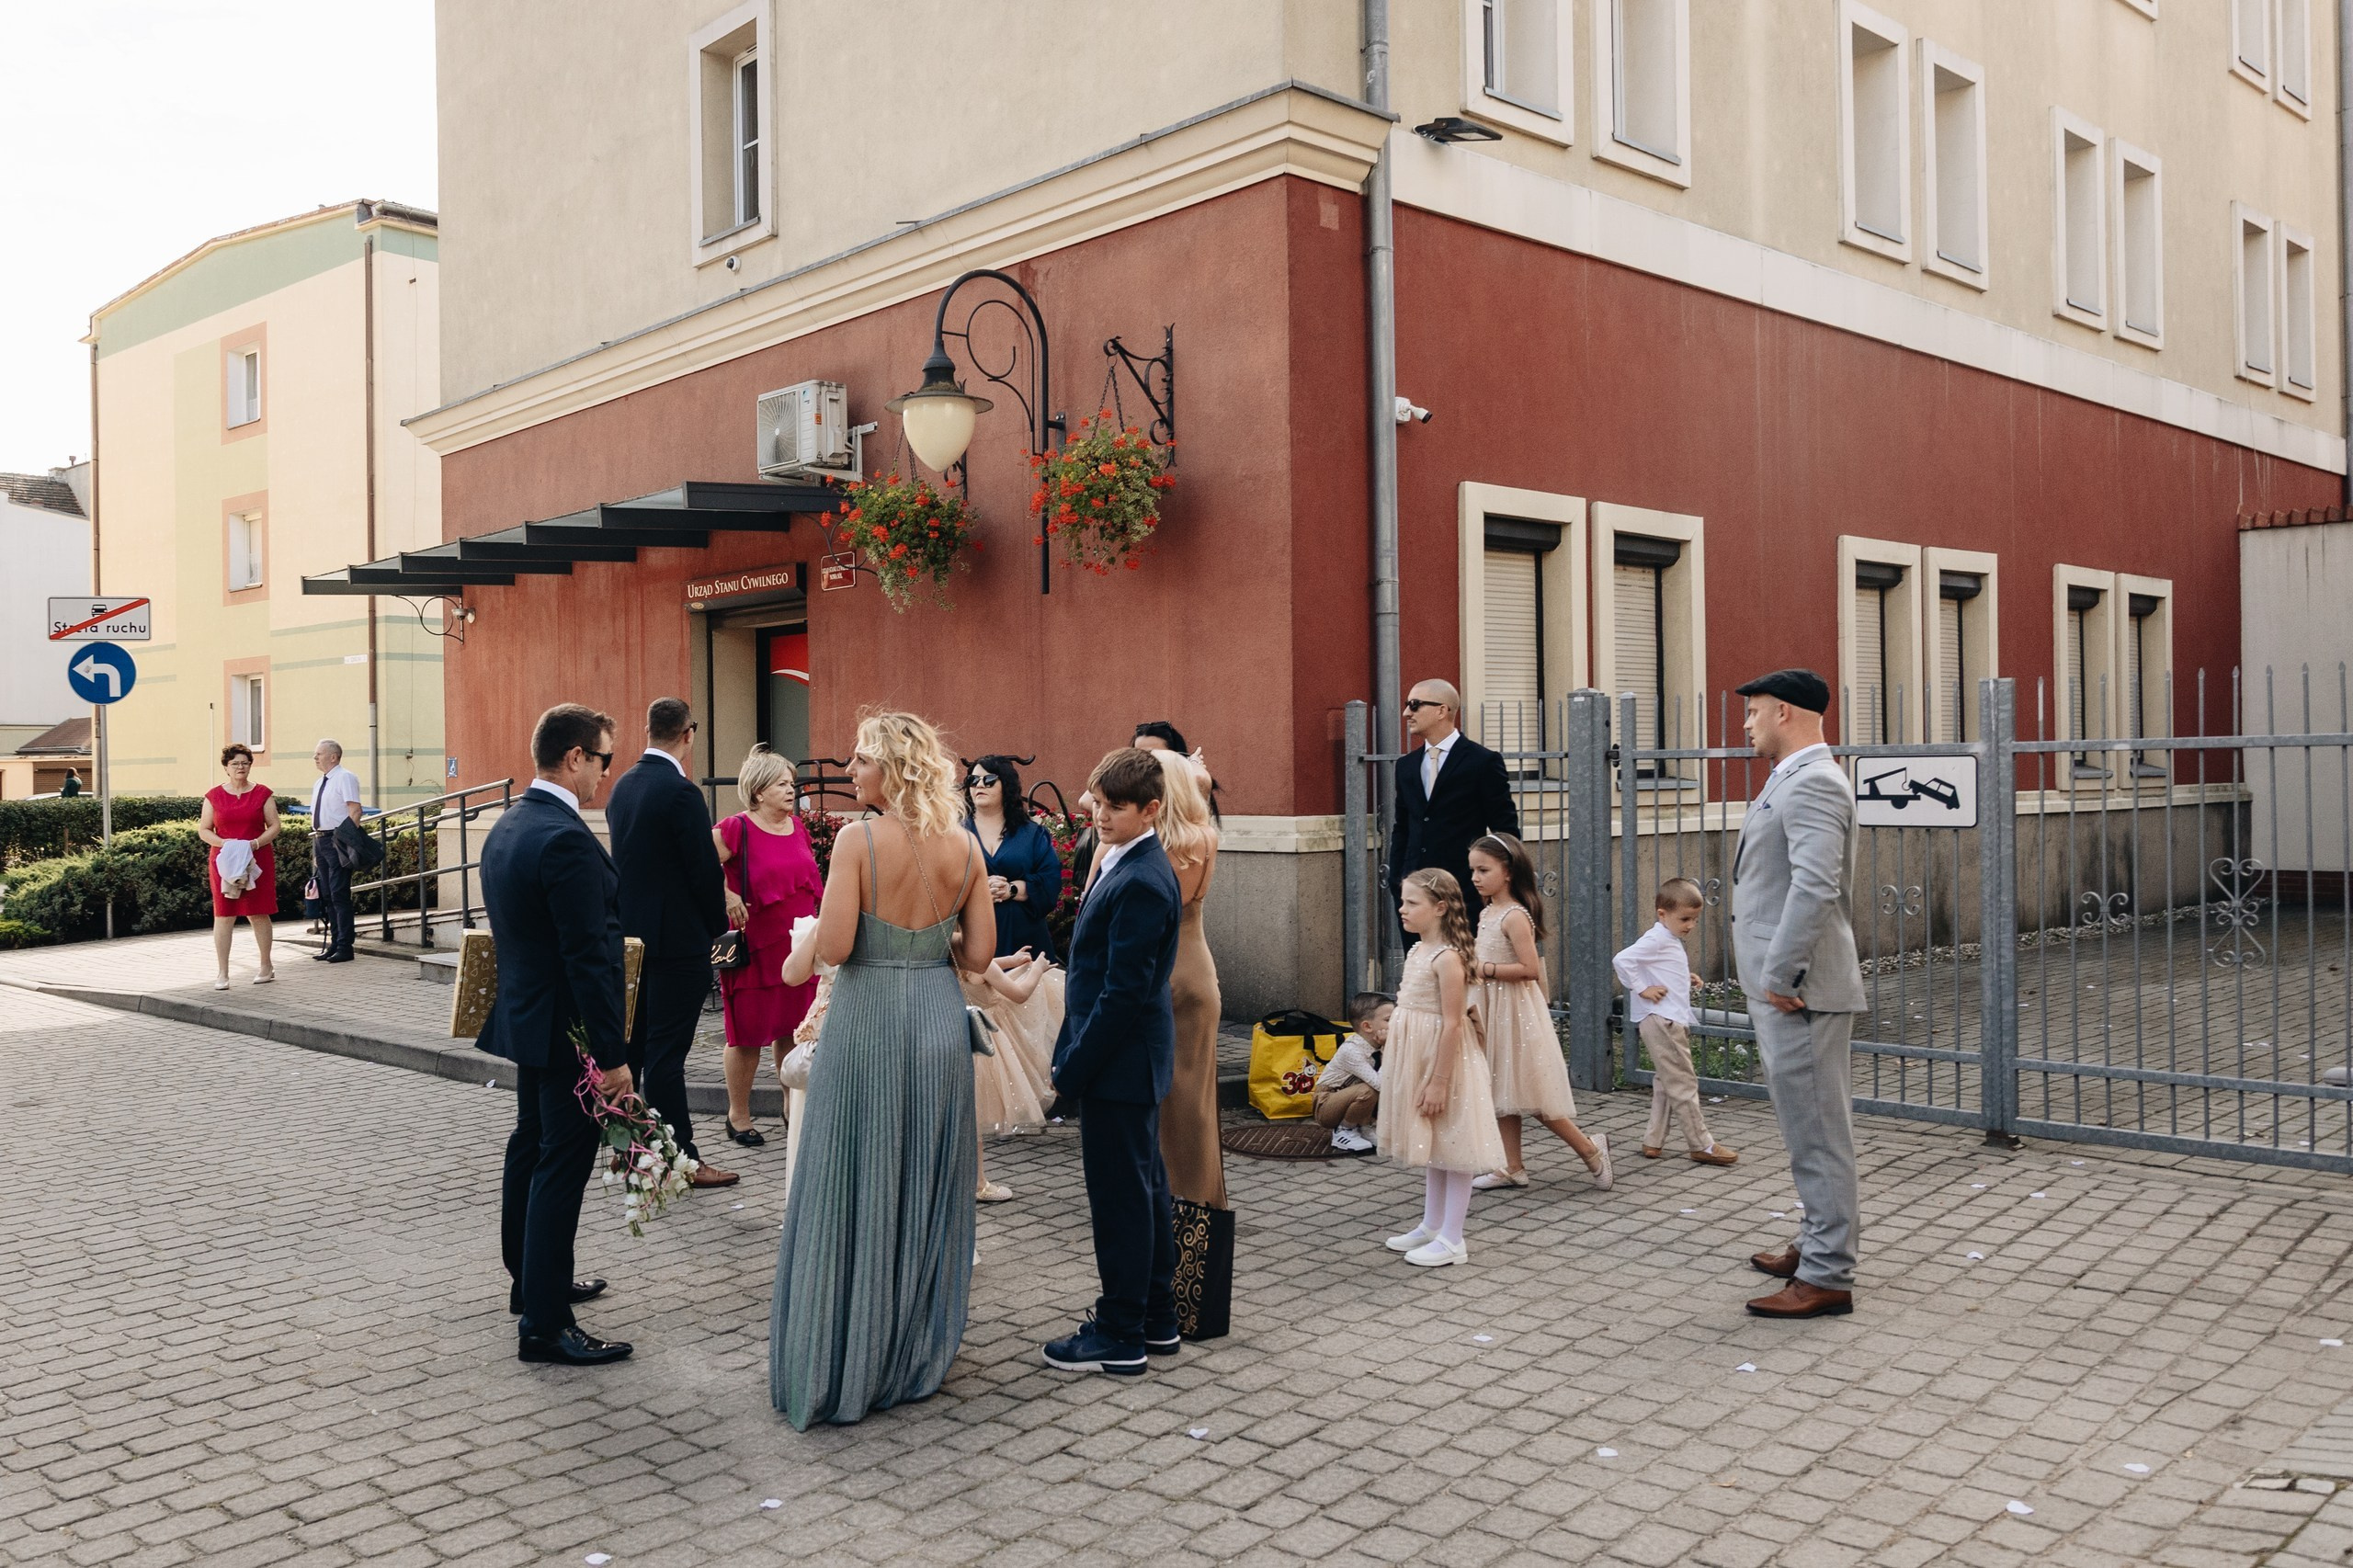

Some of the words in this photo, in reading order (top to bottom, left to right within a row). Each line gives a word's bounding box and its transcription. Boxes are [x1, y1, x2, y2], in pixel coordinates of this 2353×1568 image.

[688, 585, 713, 598] URZĄD
[714, 580, 739, 594] STANU
[741, 573, 789, 590] CYWILNEGO
[53, 621, 98, 633] Sta
[106, 621, 146, 633] ruchu
[1280, 1071, 1315, 1096] 30
